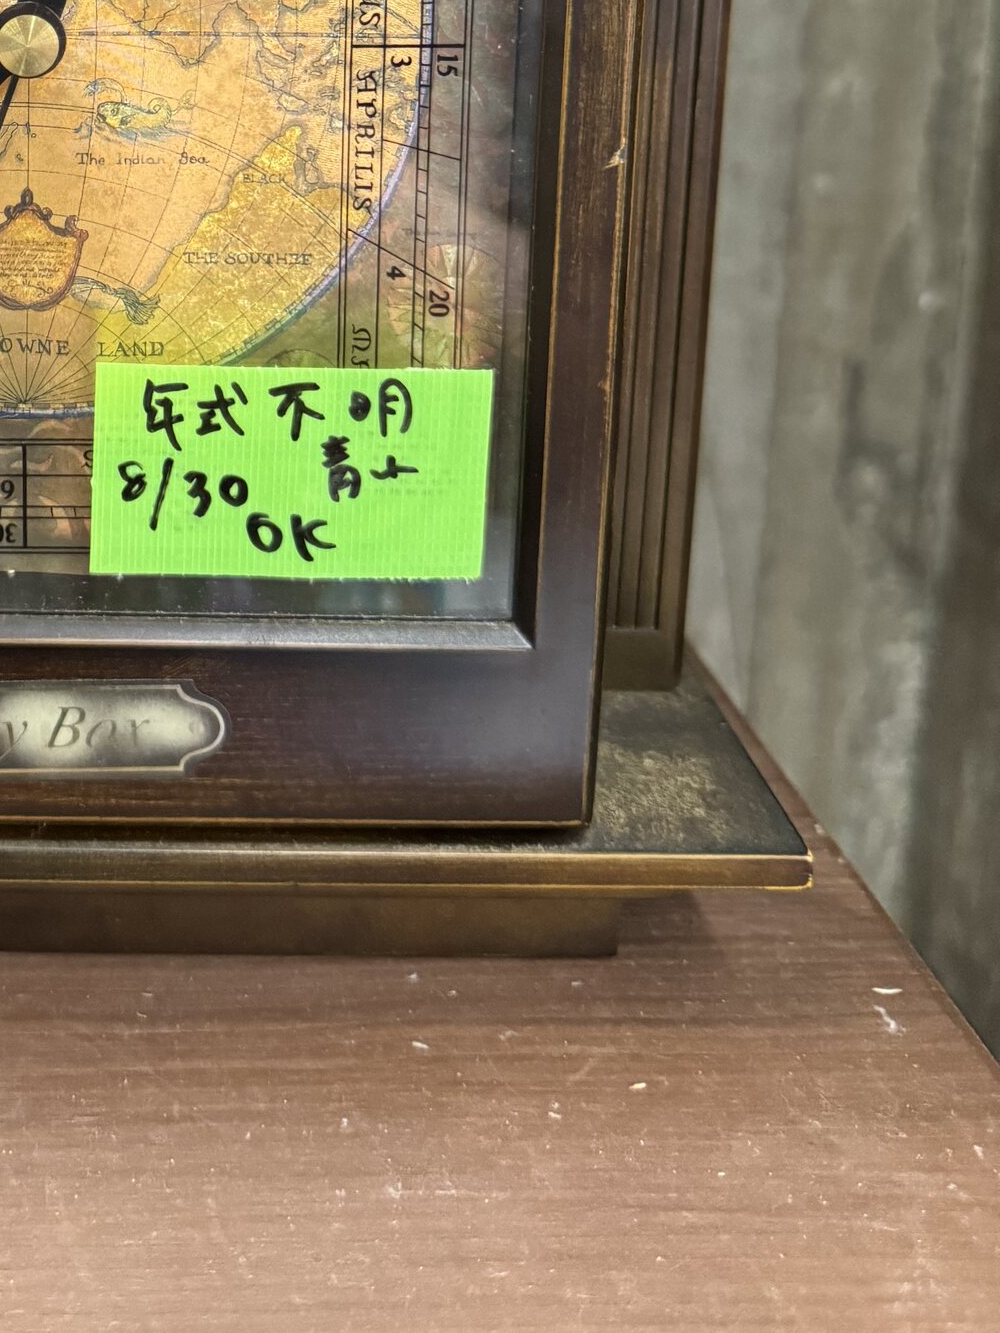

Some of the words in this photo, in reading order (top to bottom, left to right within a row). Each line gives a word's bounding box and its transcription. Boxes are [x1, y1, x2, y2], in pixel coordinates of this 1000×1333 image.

[391, 56, 412, 68] 3
[437, 53, 460, 78] 15
[352, 70, 378, 217] APRILIS
[75, 153, 105, 166] The
[116, 152, 166, 165] Indian
[183, 251, 218, 264] THE
[386, 265, 407, 281] 4
[428, 289, 451, 318] 20
[97, 341, 166, 358] LAND
[0, 479, 15, 500] 6
[117, 457, 249, 531] 8/30
[246, 512, 337, 562] OK
